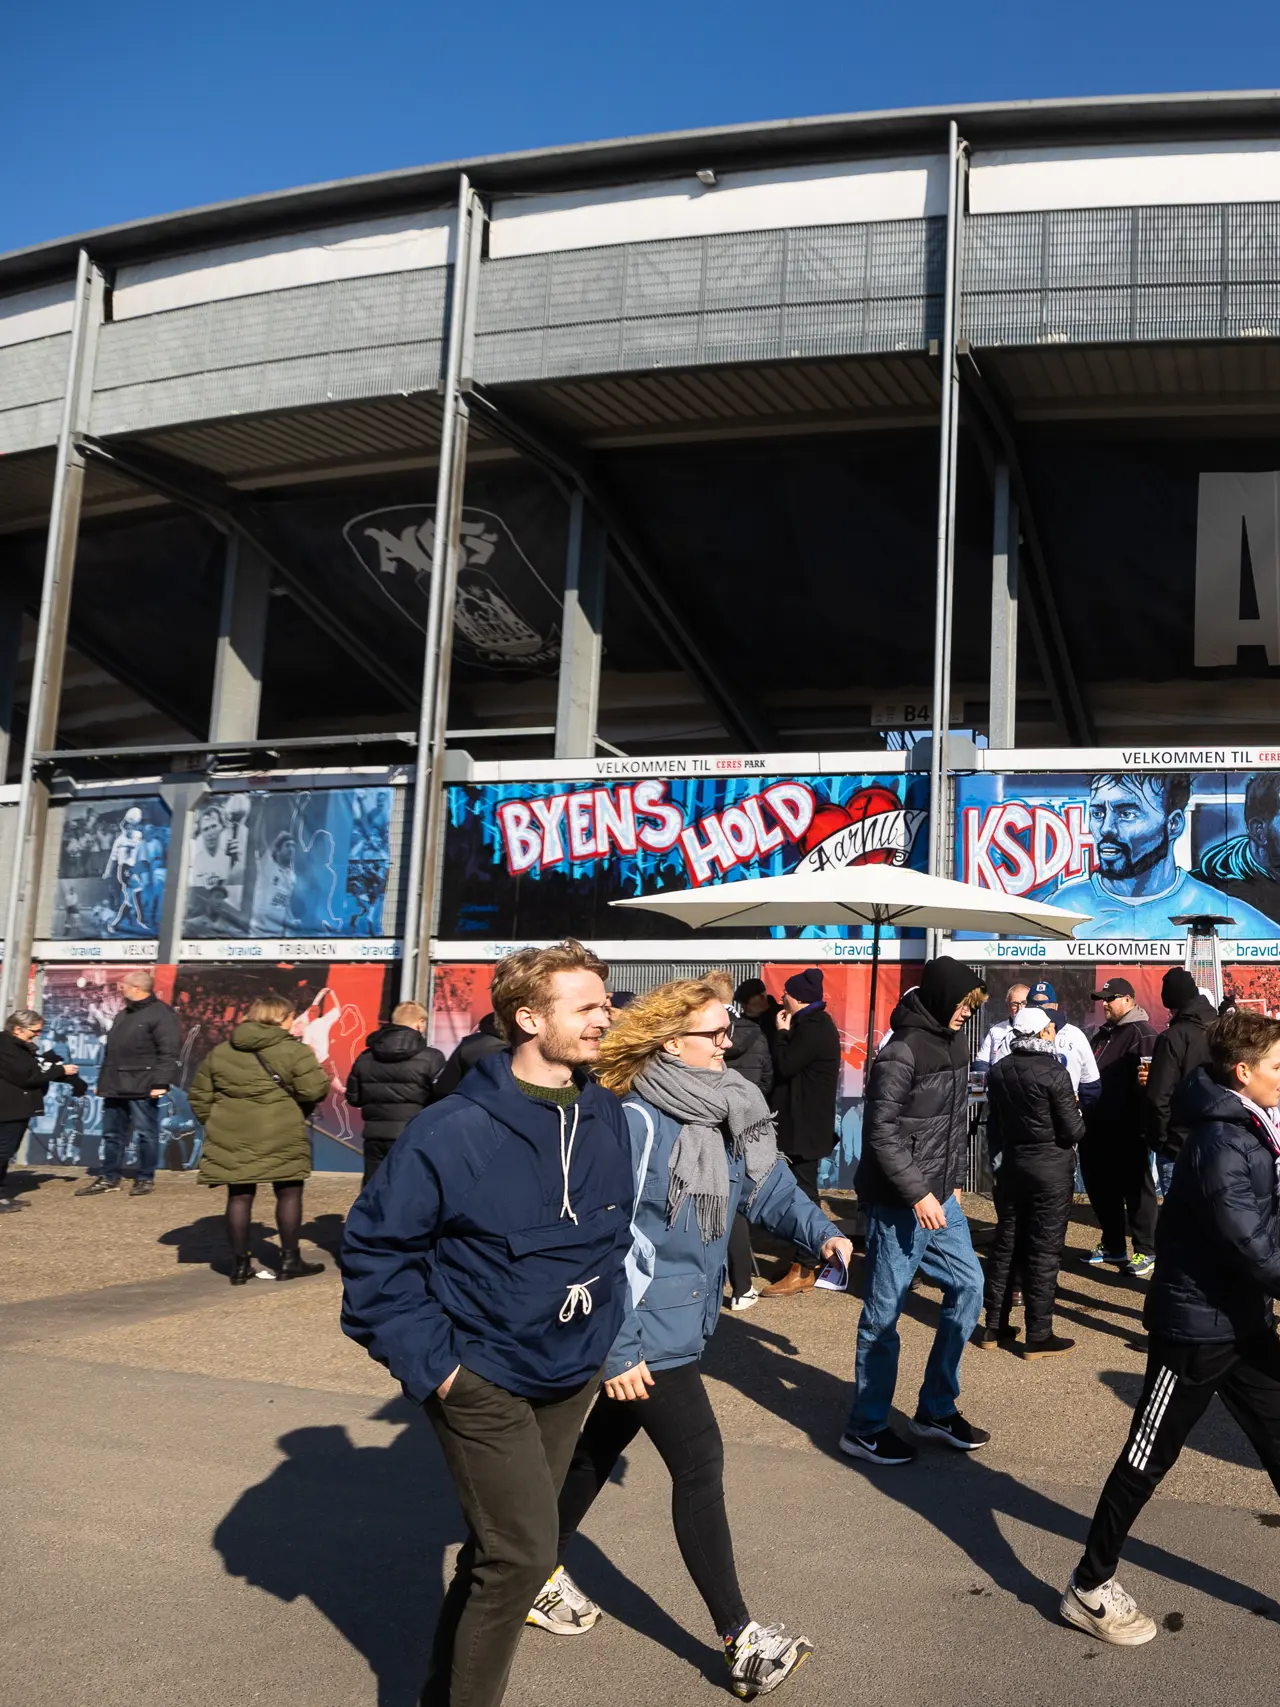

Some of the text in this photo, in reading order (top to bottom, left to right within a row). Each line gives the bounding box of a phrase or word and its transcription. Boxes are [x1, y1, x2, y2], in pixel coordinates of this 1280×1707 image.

[904, 705, 930, 722] B4
[1122, 751, 1225, 764] VELKOMMEN
[1231, 751, 1253, 763] TIL
[596, 759, 766, 774] VELKOMMEN TIL CERES PARK
[498, 780, 683, 876] BYENS
[681, 781, 816, 888] HOLD
[963, 800, 1100, 895] KSDH
[278, 944, 336, 955] TRIBUNEN
[997, 943, 1046, 957] bravida
[1067, 943, 1170, 956] VELKOMMEN
